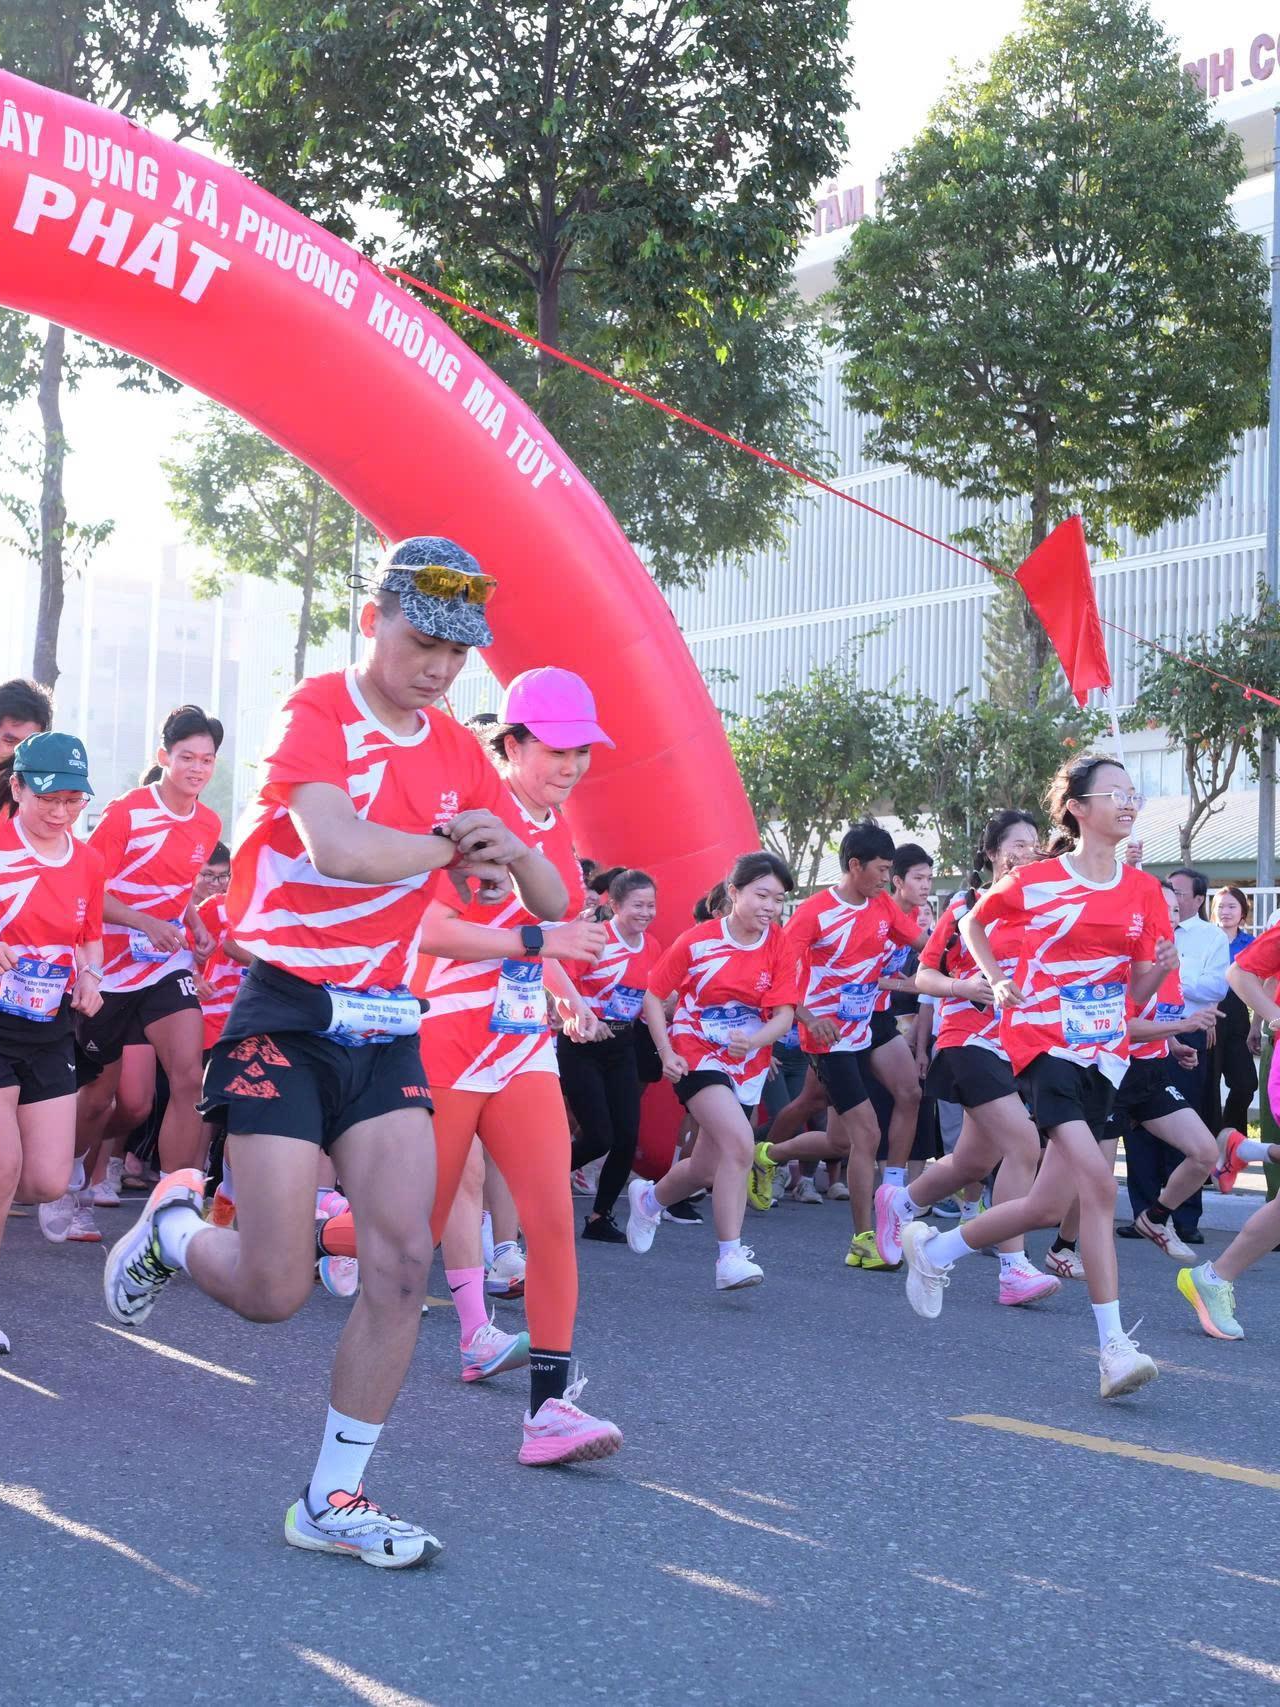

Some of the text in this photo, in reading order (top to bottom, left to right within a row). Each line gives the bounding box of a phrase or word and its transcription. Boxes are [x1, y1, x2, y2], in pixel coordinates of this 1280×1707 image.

[1250, 33, 1280, 80] C
[13, 173, 232, 305] PHÁT
[63, 128, 160, 201] DỰNG
[235, 206, 359, 310] PHƯỜNG
[367, 291, 464, 393] KHÔNG
[461, 376, 508, 442] MA
[1094, 1018, 1110, 1030] 178
